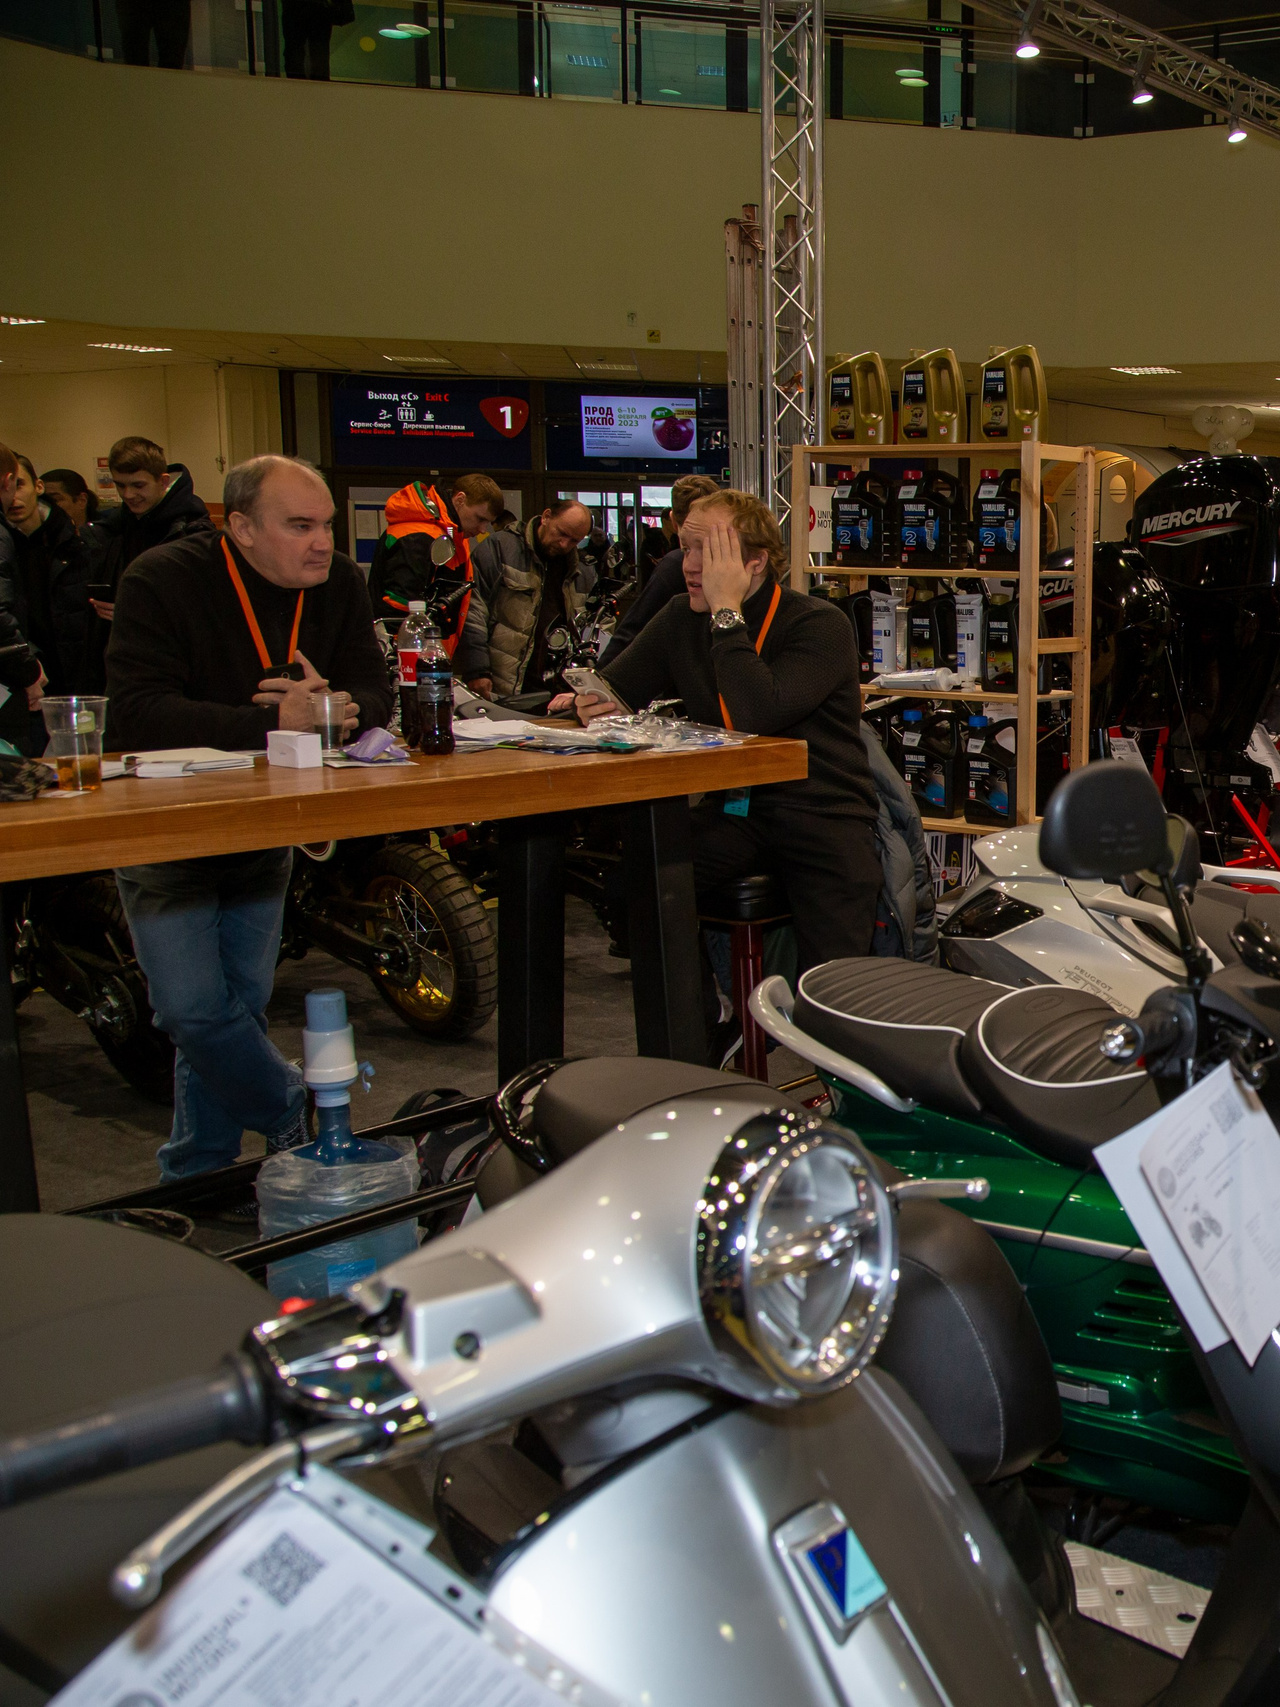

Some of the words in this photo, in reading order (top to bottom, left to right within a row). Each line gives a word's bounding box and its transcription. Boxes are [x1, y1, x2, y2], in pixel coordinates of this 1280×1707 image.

[368, 391, 399, 401] Выход
[425, 393, 442, 402] Exit
[500, 406, 511, 429] 1
[584, 407, 613, 417] ПРОД
[584, 417, 615, 426] ЭКСПО
[1141, 501, 1242, 535] MERCURY
[840, 530, 851, 544] 2
[905, 531, 917, 545] 2
[983, 532, 996, 547] 2
[1142, 578, 1160, 593] 10
[401, 665, 414, 673] Cola
[1074, 965, 1113, 992] PEUGEOT
